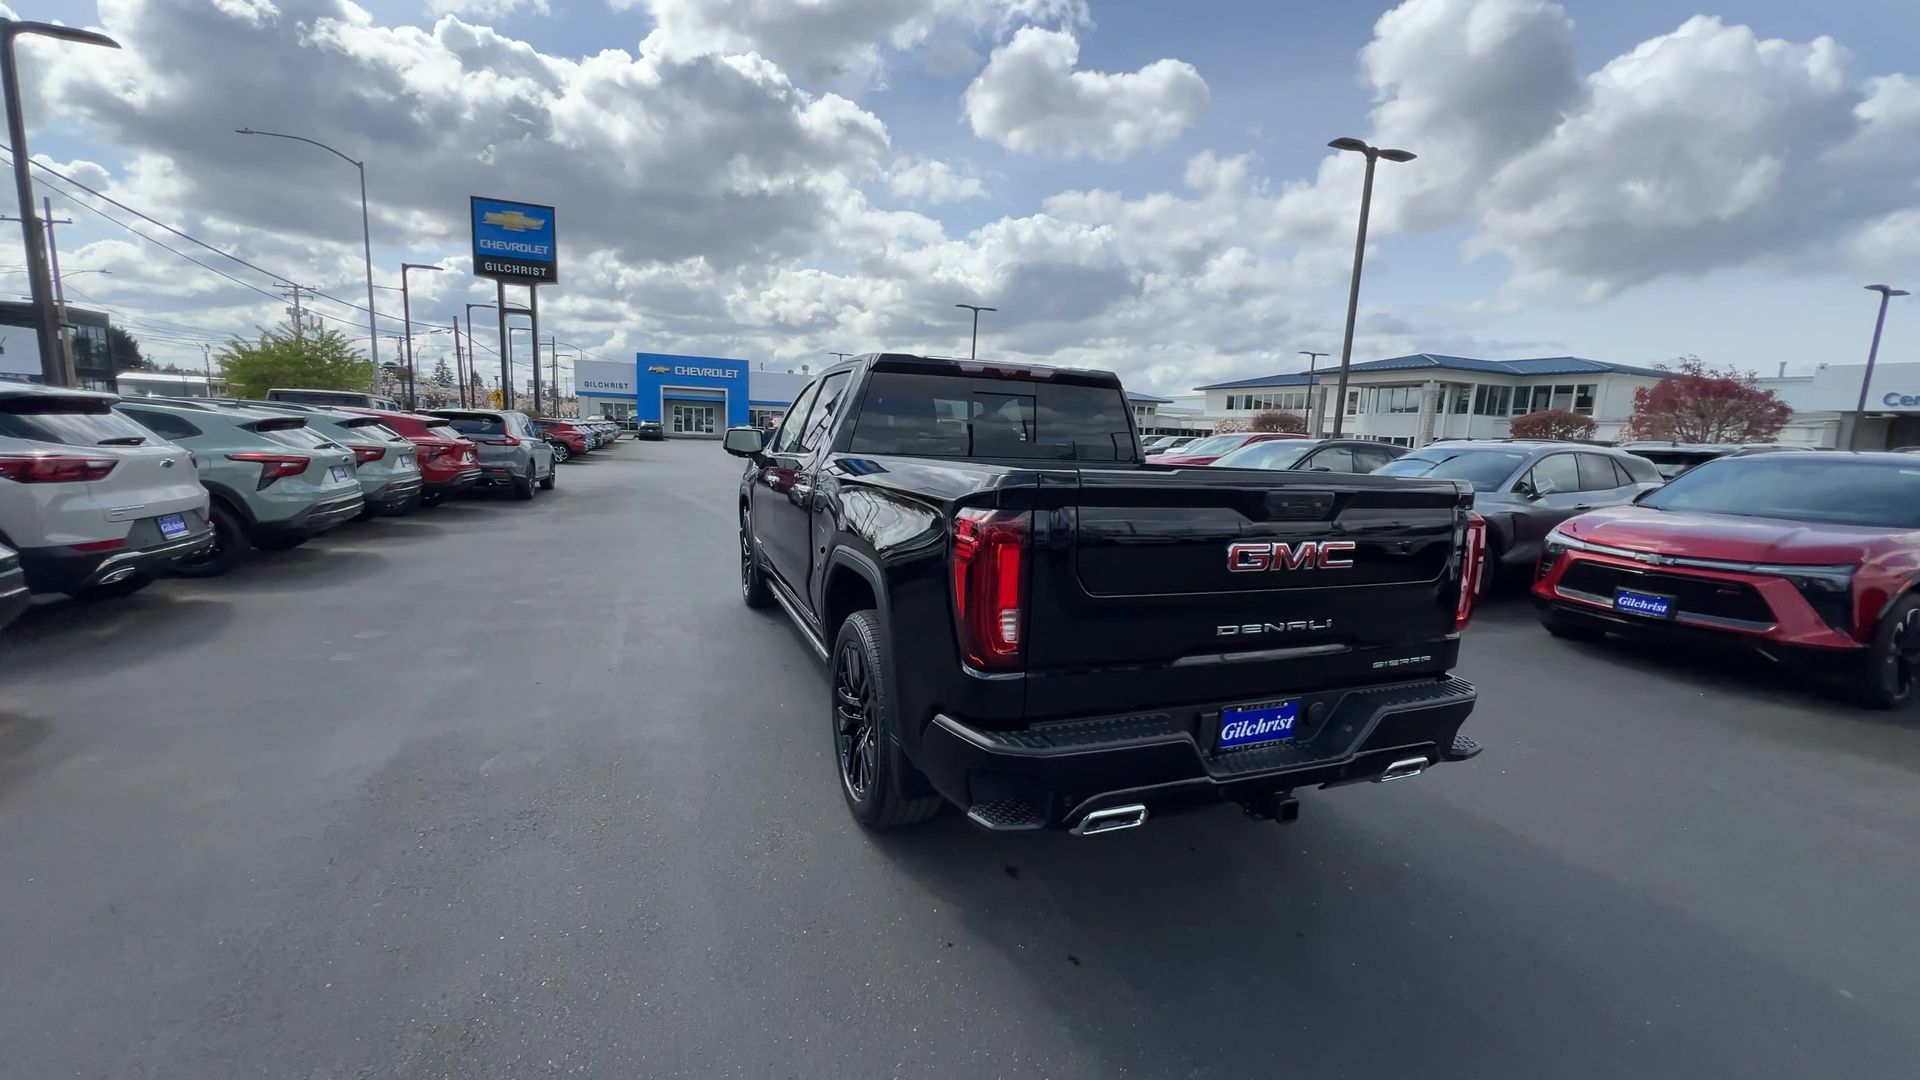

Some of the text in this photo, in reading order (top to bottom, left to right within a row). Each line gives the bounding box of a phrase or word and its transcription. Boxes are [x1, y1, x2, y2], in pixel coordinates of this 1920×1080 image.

[480, 239, 549, 255] CHEVROLET
[484, 261, 547, 277] GILCHRIST
[674, 365, 739, 379] CHEVROLET
[583, 380, 629, 390] GILCHRIST
[1227, 541, 1356, 572] GMC
[1618, 596, 1667, 612] Gilchrist
[1216, 619, 1332, 636] DENALI
[1372, 655, 1431, 669] SIERRA
[1221, 715, 1295, 741] Gilchrist
